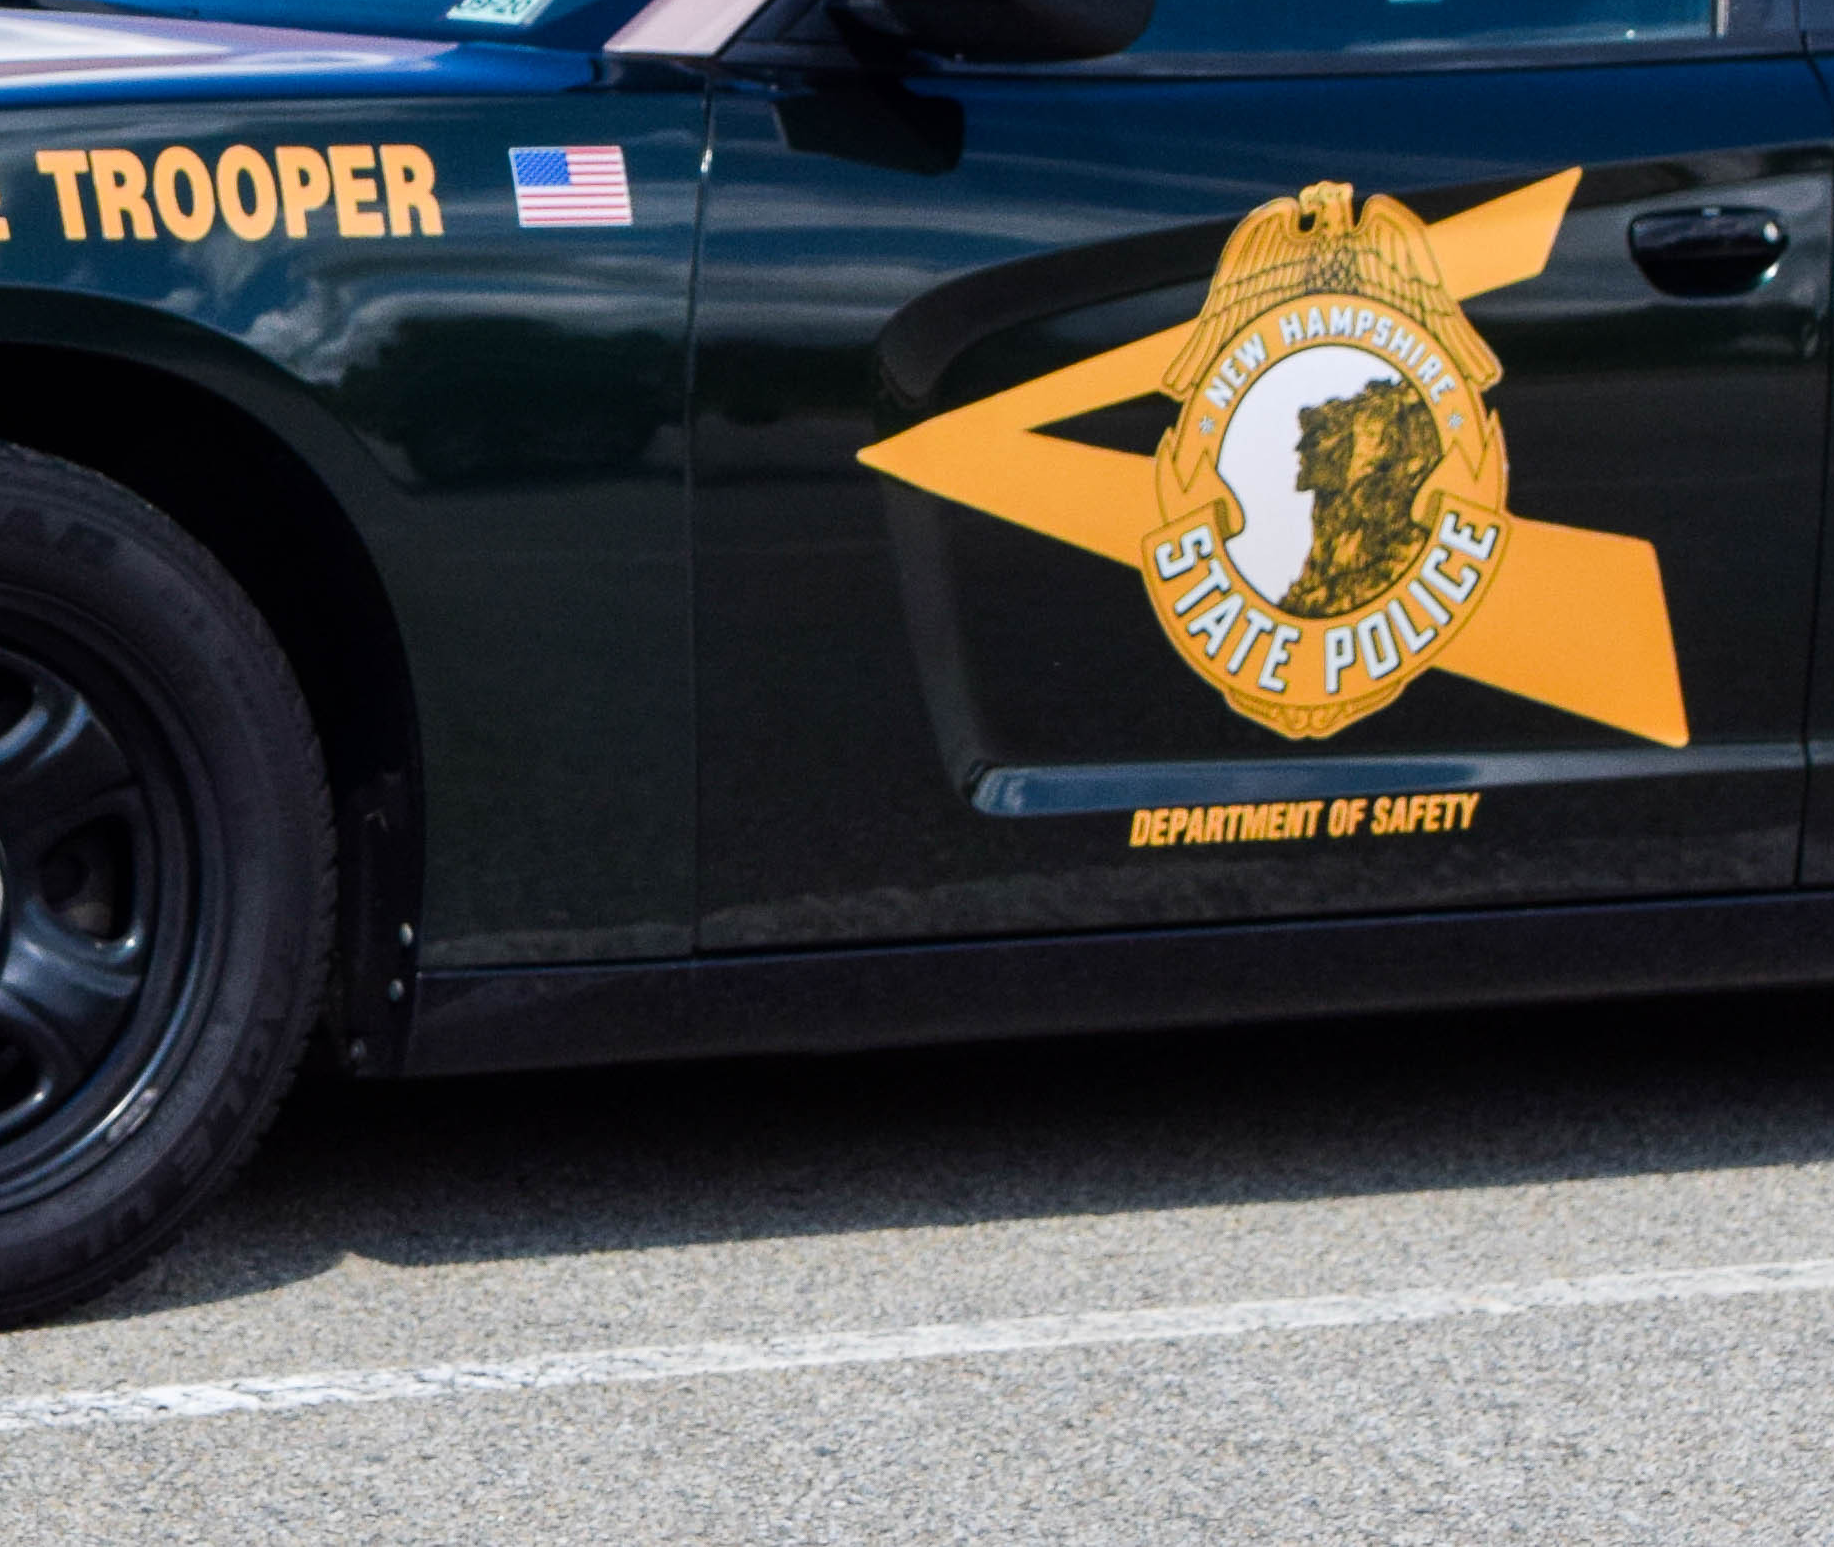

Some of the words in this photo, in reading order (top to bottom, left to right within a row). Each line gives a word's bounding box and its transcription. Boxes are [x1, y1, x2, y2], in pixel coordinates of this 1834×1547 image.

[36, 144, 444, 242] TROOPER
[1204, 333, 1268, 409] NEW
[1279, 309, 1456, 404] HAMPSHIRE
[1154, 524, 1302, 693] STATE
[1324, 511, 1499, 693] POLICE
[1130, 803, 1324, 847] DEPARTMENT
[1328, 798, 1367, 837] OF
[1370, 791, 1480, 835] SAFETY
